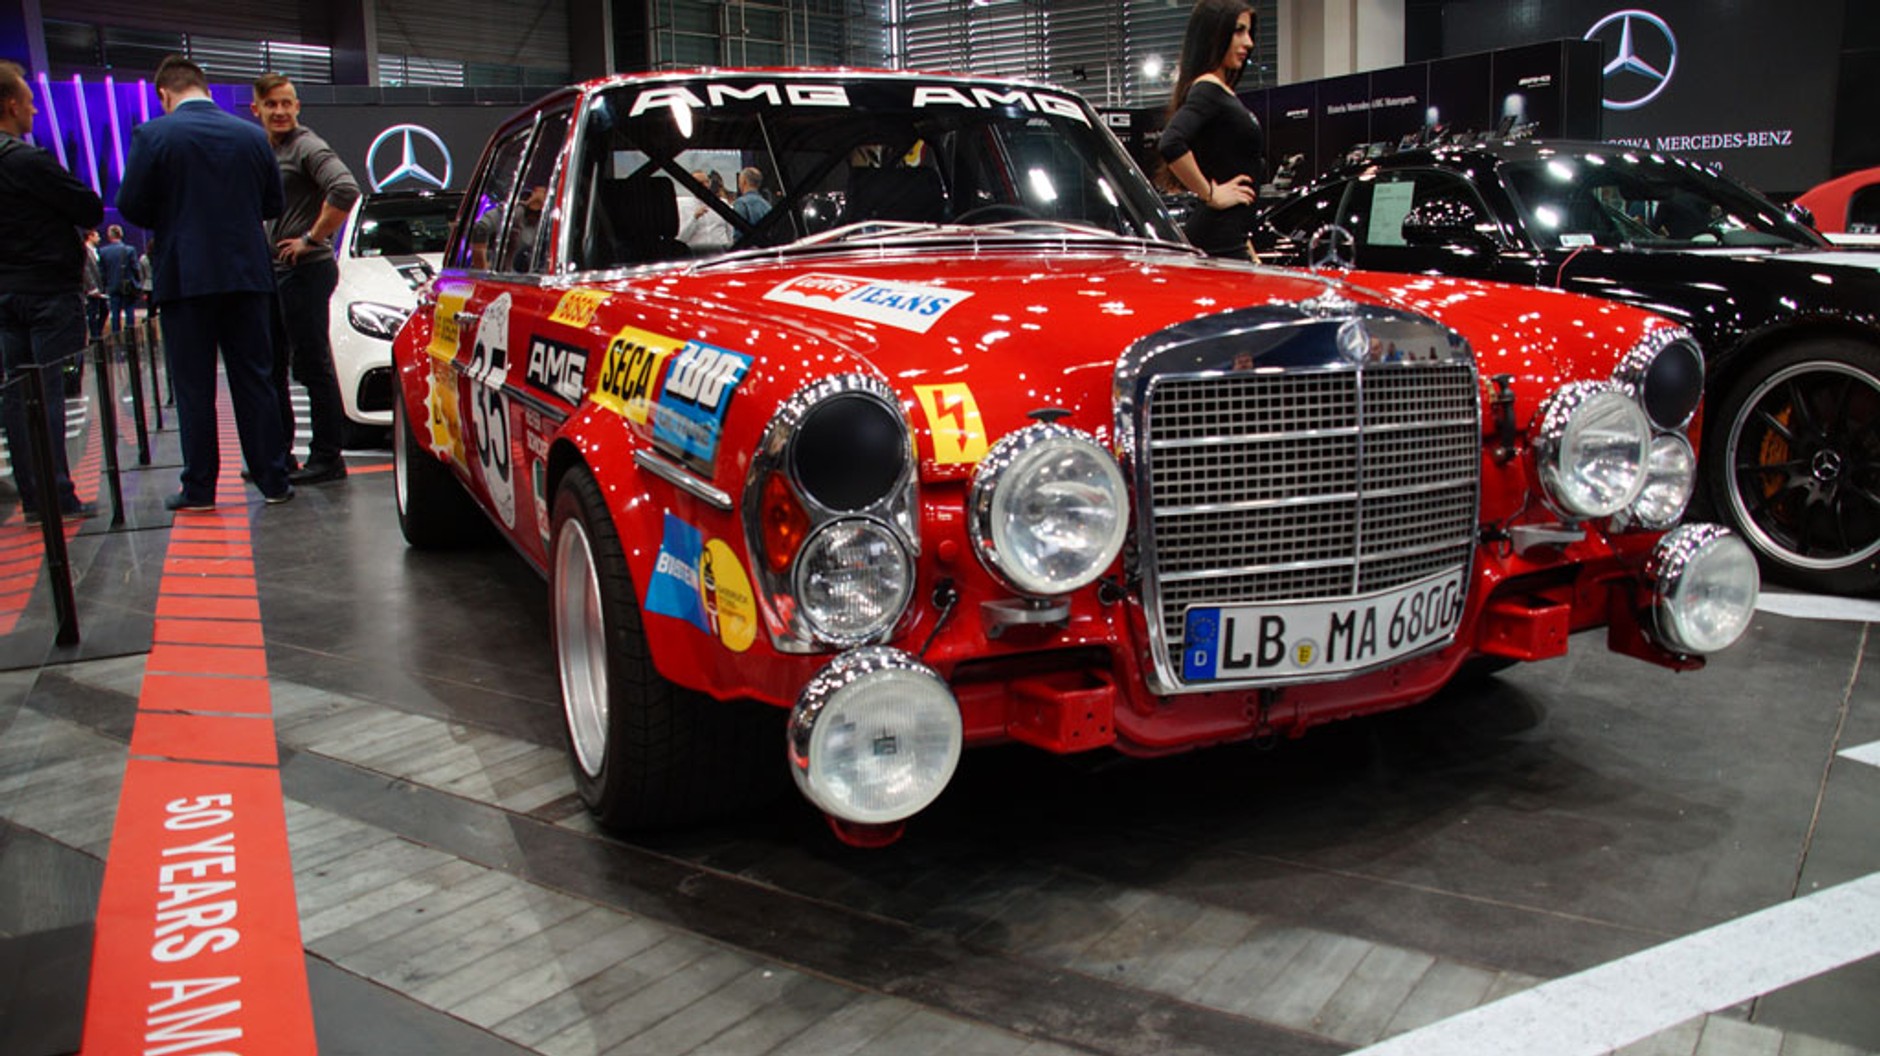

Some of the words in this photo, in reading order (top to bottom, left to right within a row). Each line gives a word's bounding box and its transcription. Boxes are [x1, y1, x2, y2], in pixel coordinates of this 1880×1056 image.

[629, 84, 851, 117] AMG
[912, 86, 1093, 130] AMG
[1656, 130, 1793, 151] MERCEDES-BENZ
[850, 286, 951, 316] JEANS
[527, 341, 587, 400] AMG
[602, 339, 657, 404] SECA
[665, 342, 748, 409] 100
[468, 341, 509, 484] 35
[1194, 650, 1207, 666] D
[1222, 615, 1286, 669] LB
[1326, 606, 1377, 663] MA
[163, 793, 234, 831] 50
[151, 832, 240, 962] YEARS
[143, 976, 244, 1056] AM
